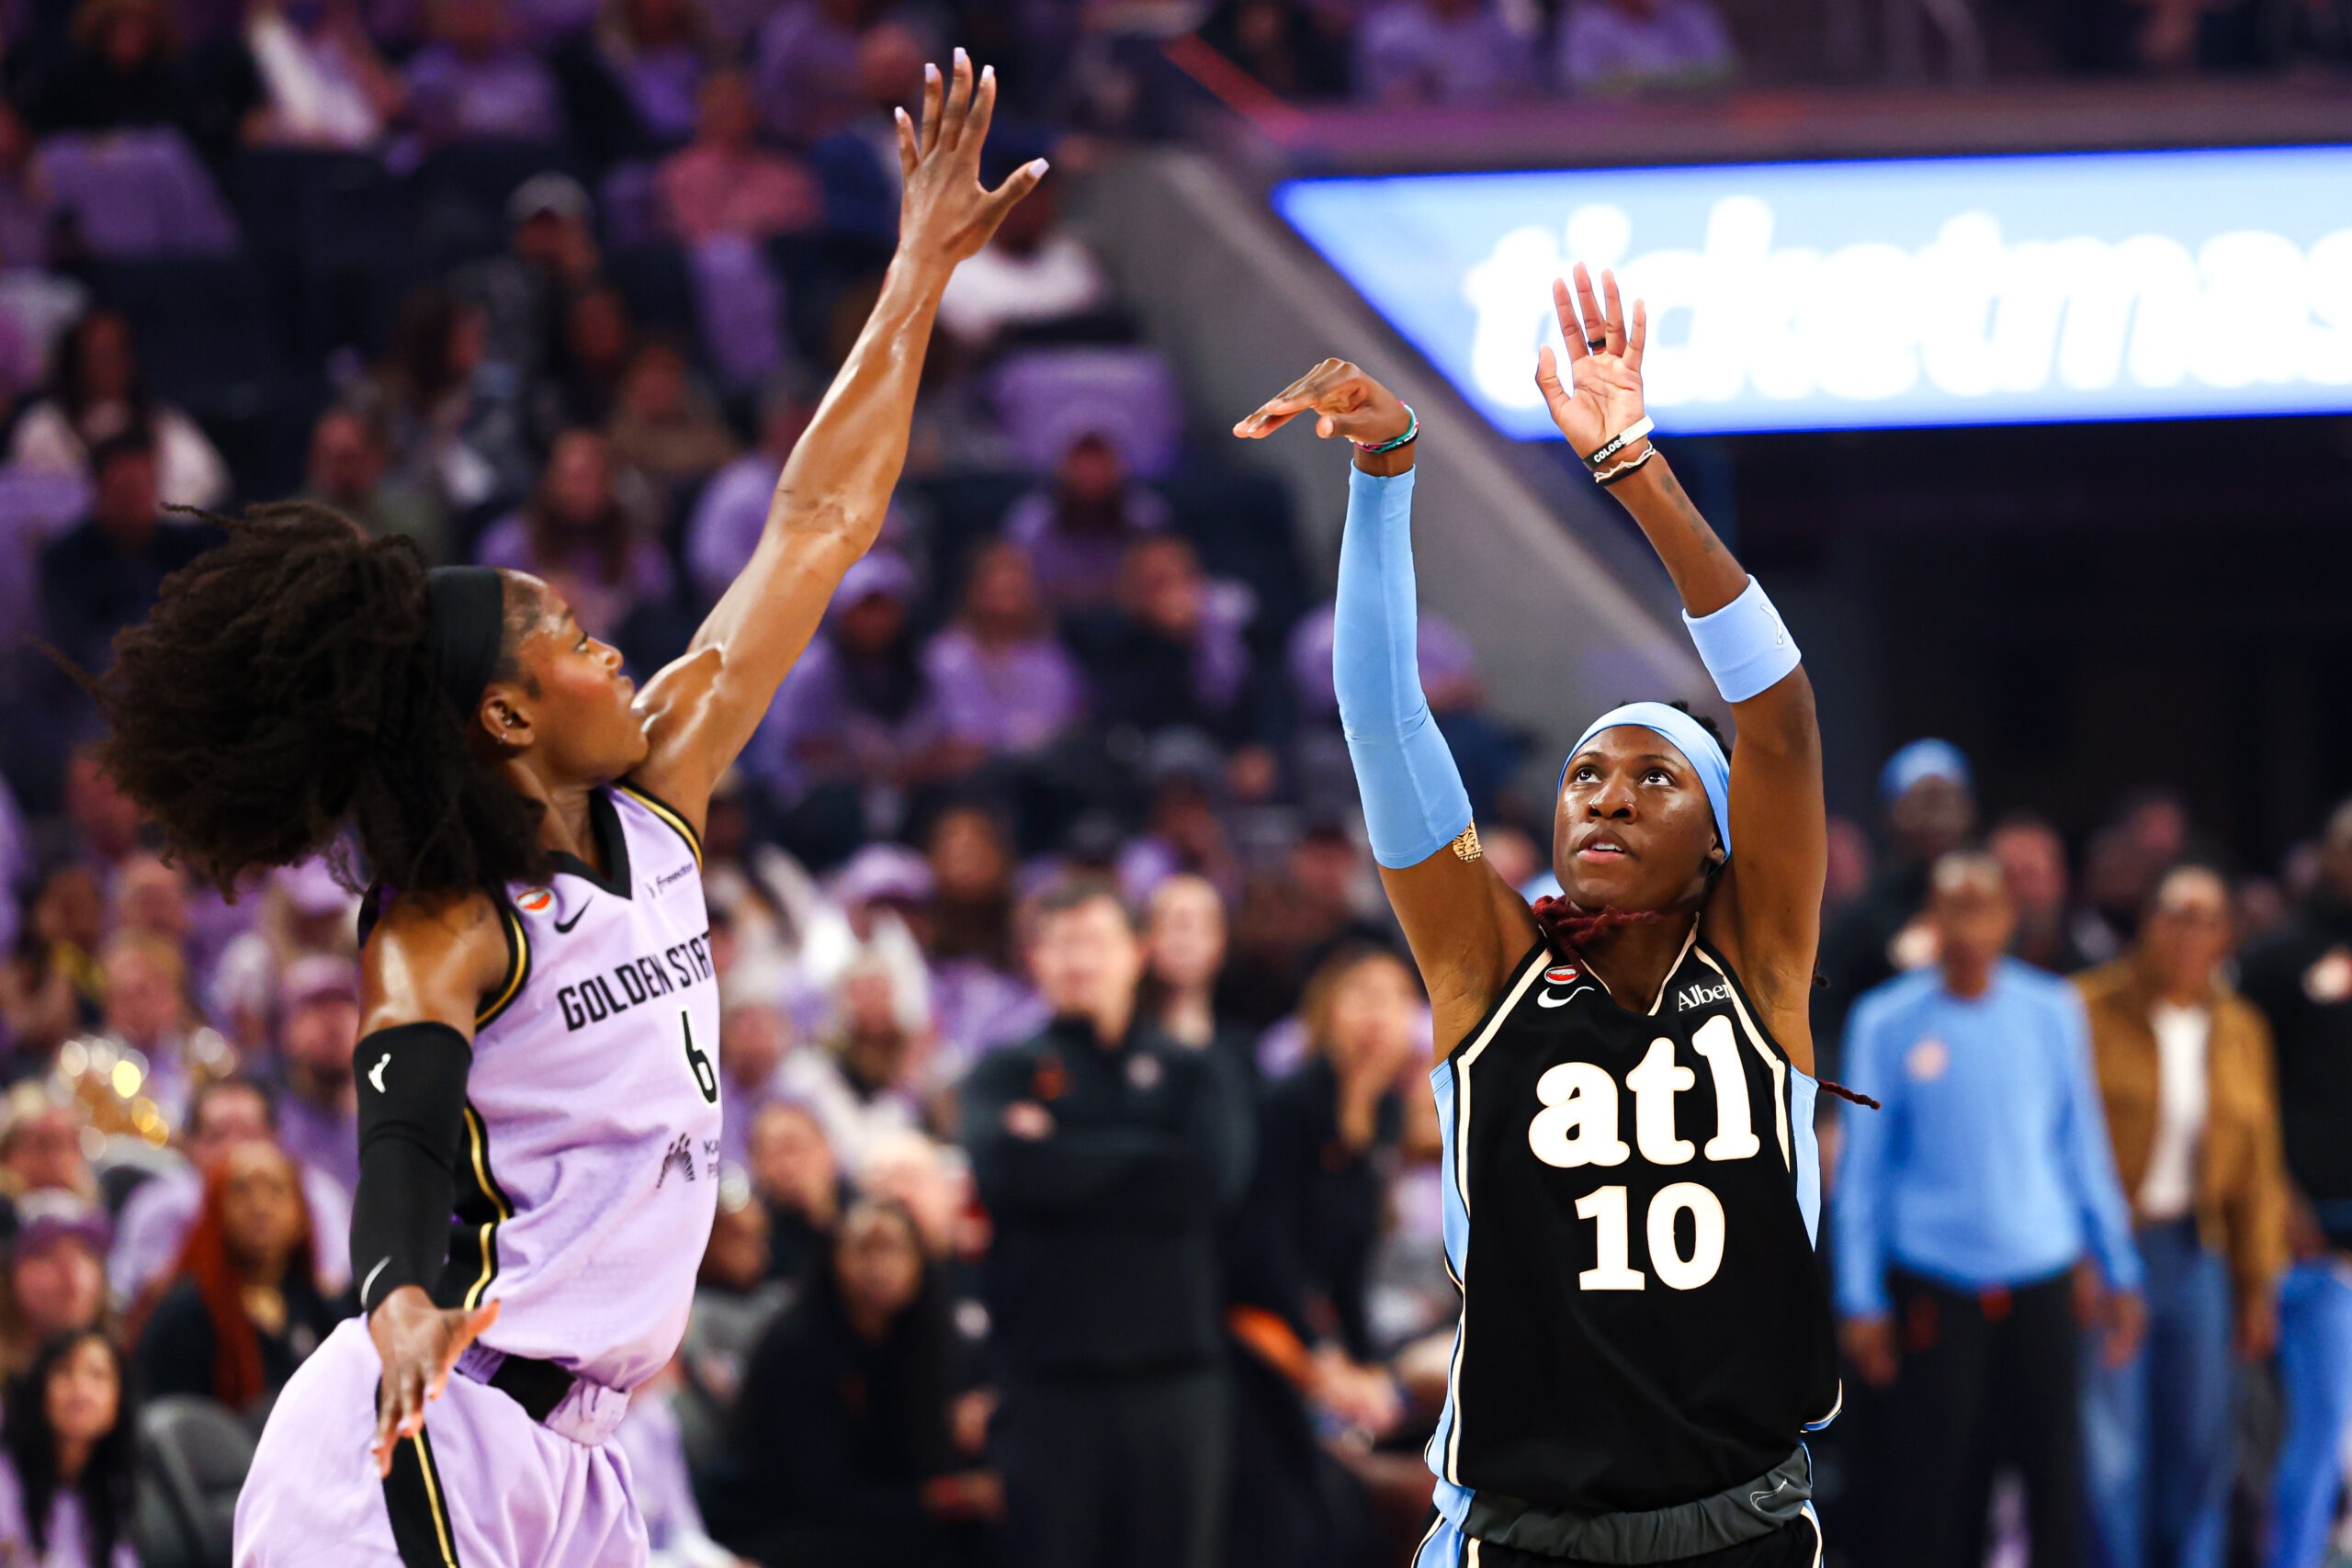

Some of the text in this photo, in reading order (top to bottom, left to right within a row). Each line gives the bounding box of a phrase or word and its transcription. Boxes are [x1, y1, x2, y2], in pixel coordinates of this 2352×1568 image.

[557, 954, 674, 1032] GOLDEN
[680, 1008, 718, 1105] 6
[1529, 1015, 1760, 1168] atl
[1575, 1182, 1725, 1291] 10
